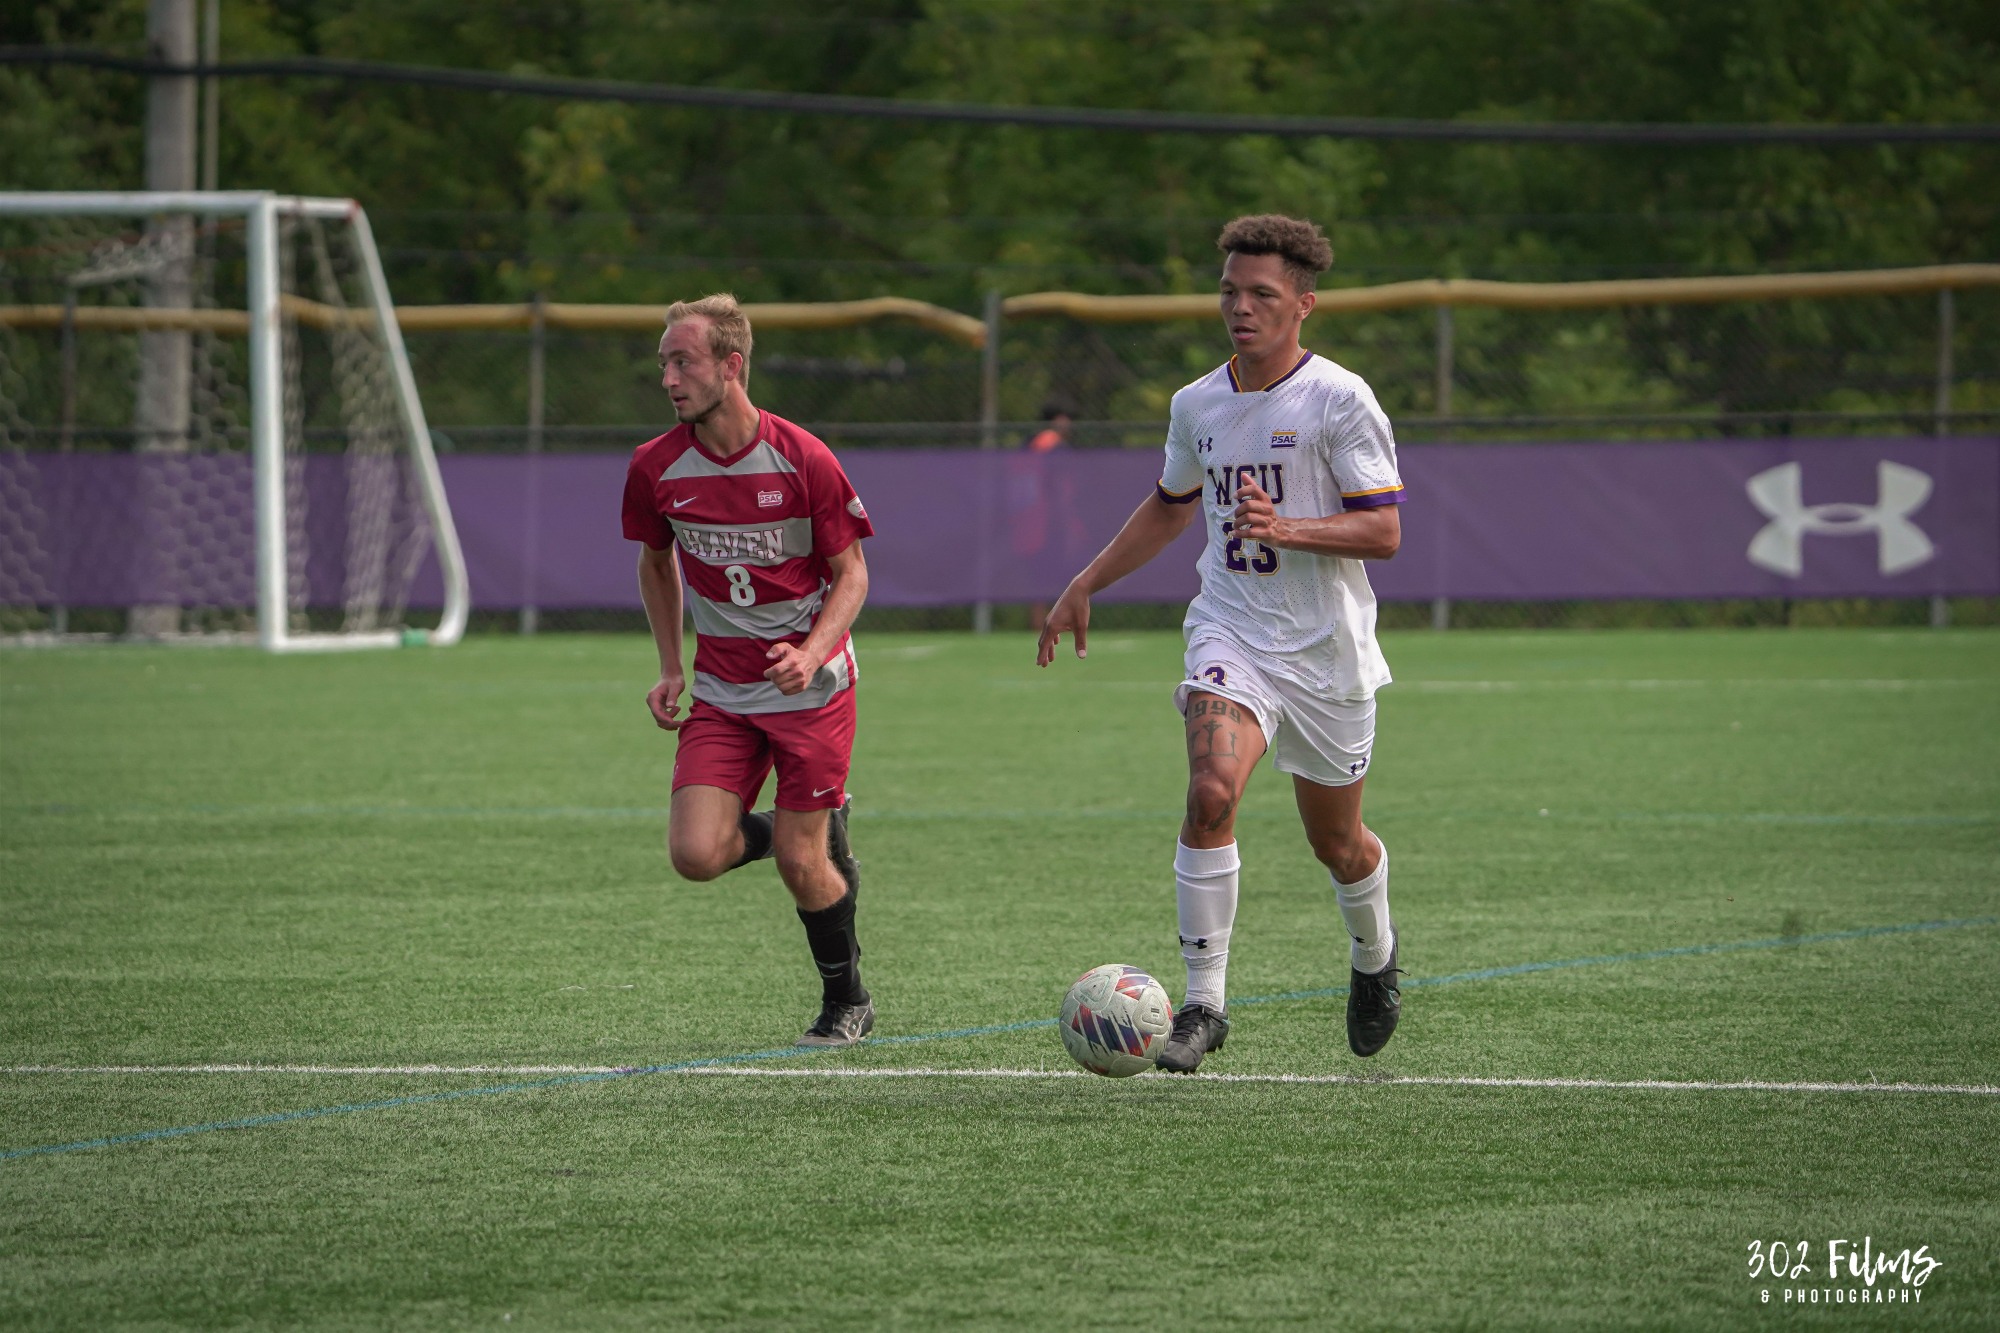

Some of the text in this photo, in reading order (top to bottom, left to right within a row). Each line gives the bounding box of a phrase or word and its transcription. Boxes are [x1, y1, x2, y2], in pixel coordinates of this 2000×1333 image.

[1271, 435, 1297, 444] PSAC
[760, 494, 782, 503] PSAC
[682, 527, 785, 561] HAVEN
[724, 565, 756, 607] 8
